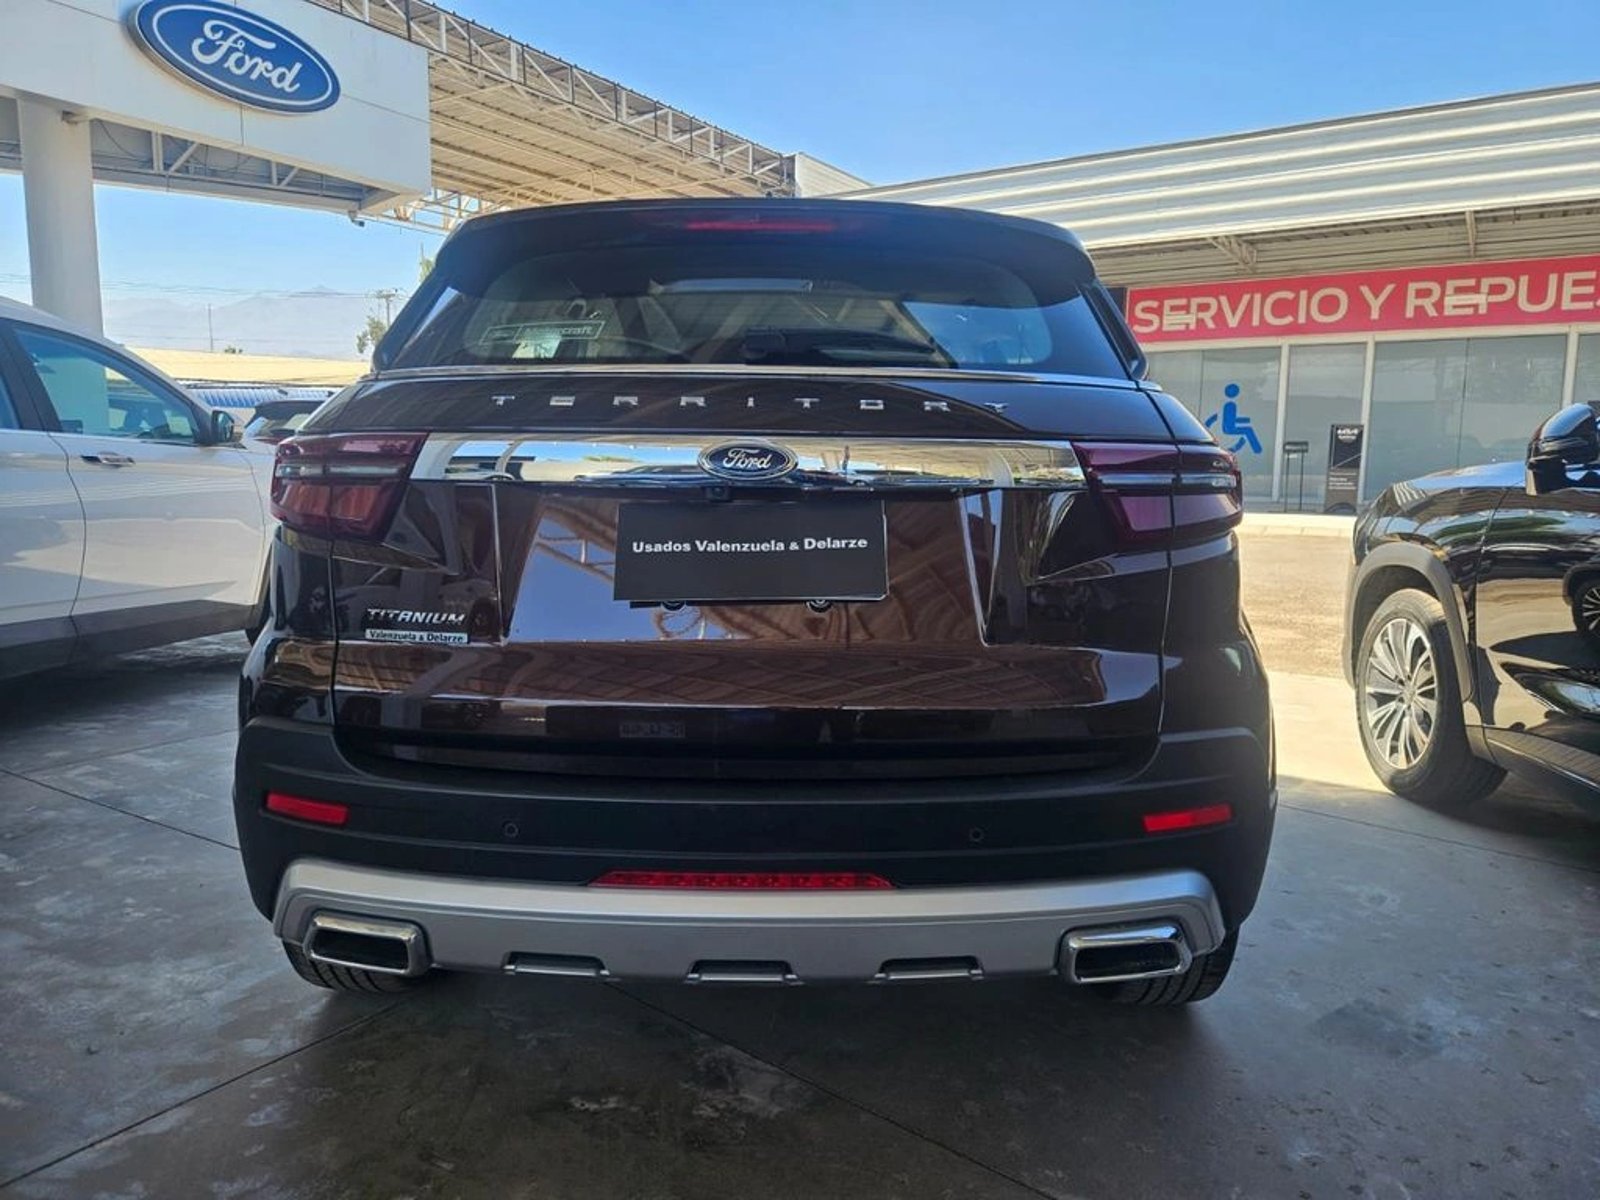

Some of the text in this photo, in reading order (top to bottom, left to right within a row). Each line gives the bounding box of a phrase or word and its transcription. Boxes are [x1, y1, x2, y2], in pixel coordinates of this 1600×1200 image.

[191, 19, 302, 93] Ford
[1132, 270, 1600, 334] SERVICIO Y REPUE
[491, 395, 1009, 413] TERRITORY
[722, 447, 773, 469] Ford
[632, 537, 868, 552] Usados Valenzuela & Delarze
[367, 608, 466, 624] TITANIUM
[369, 630, 416, 641] Valenzuela
[427, 632, 464, 643] Delarze
